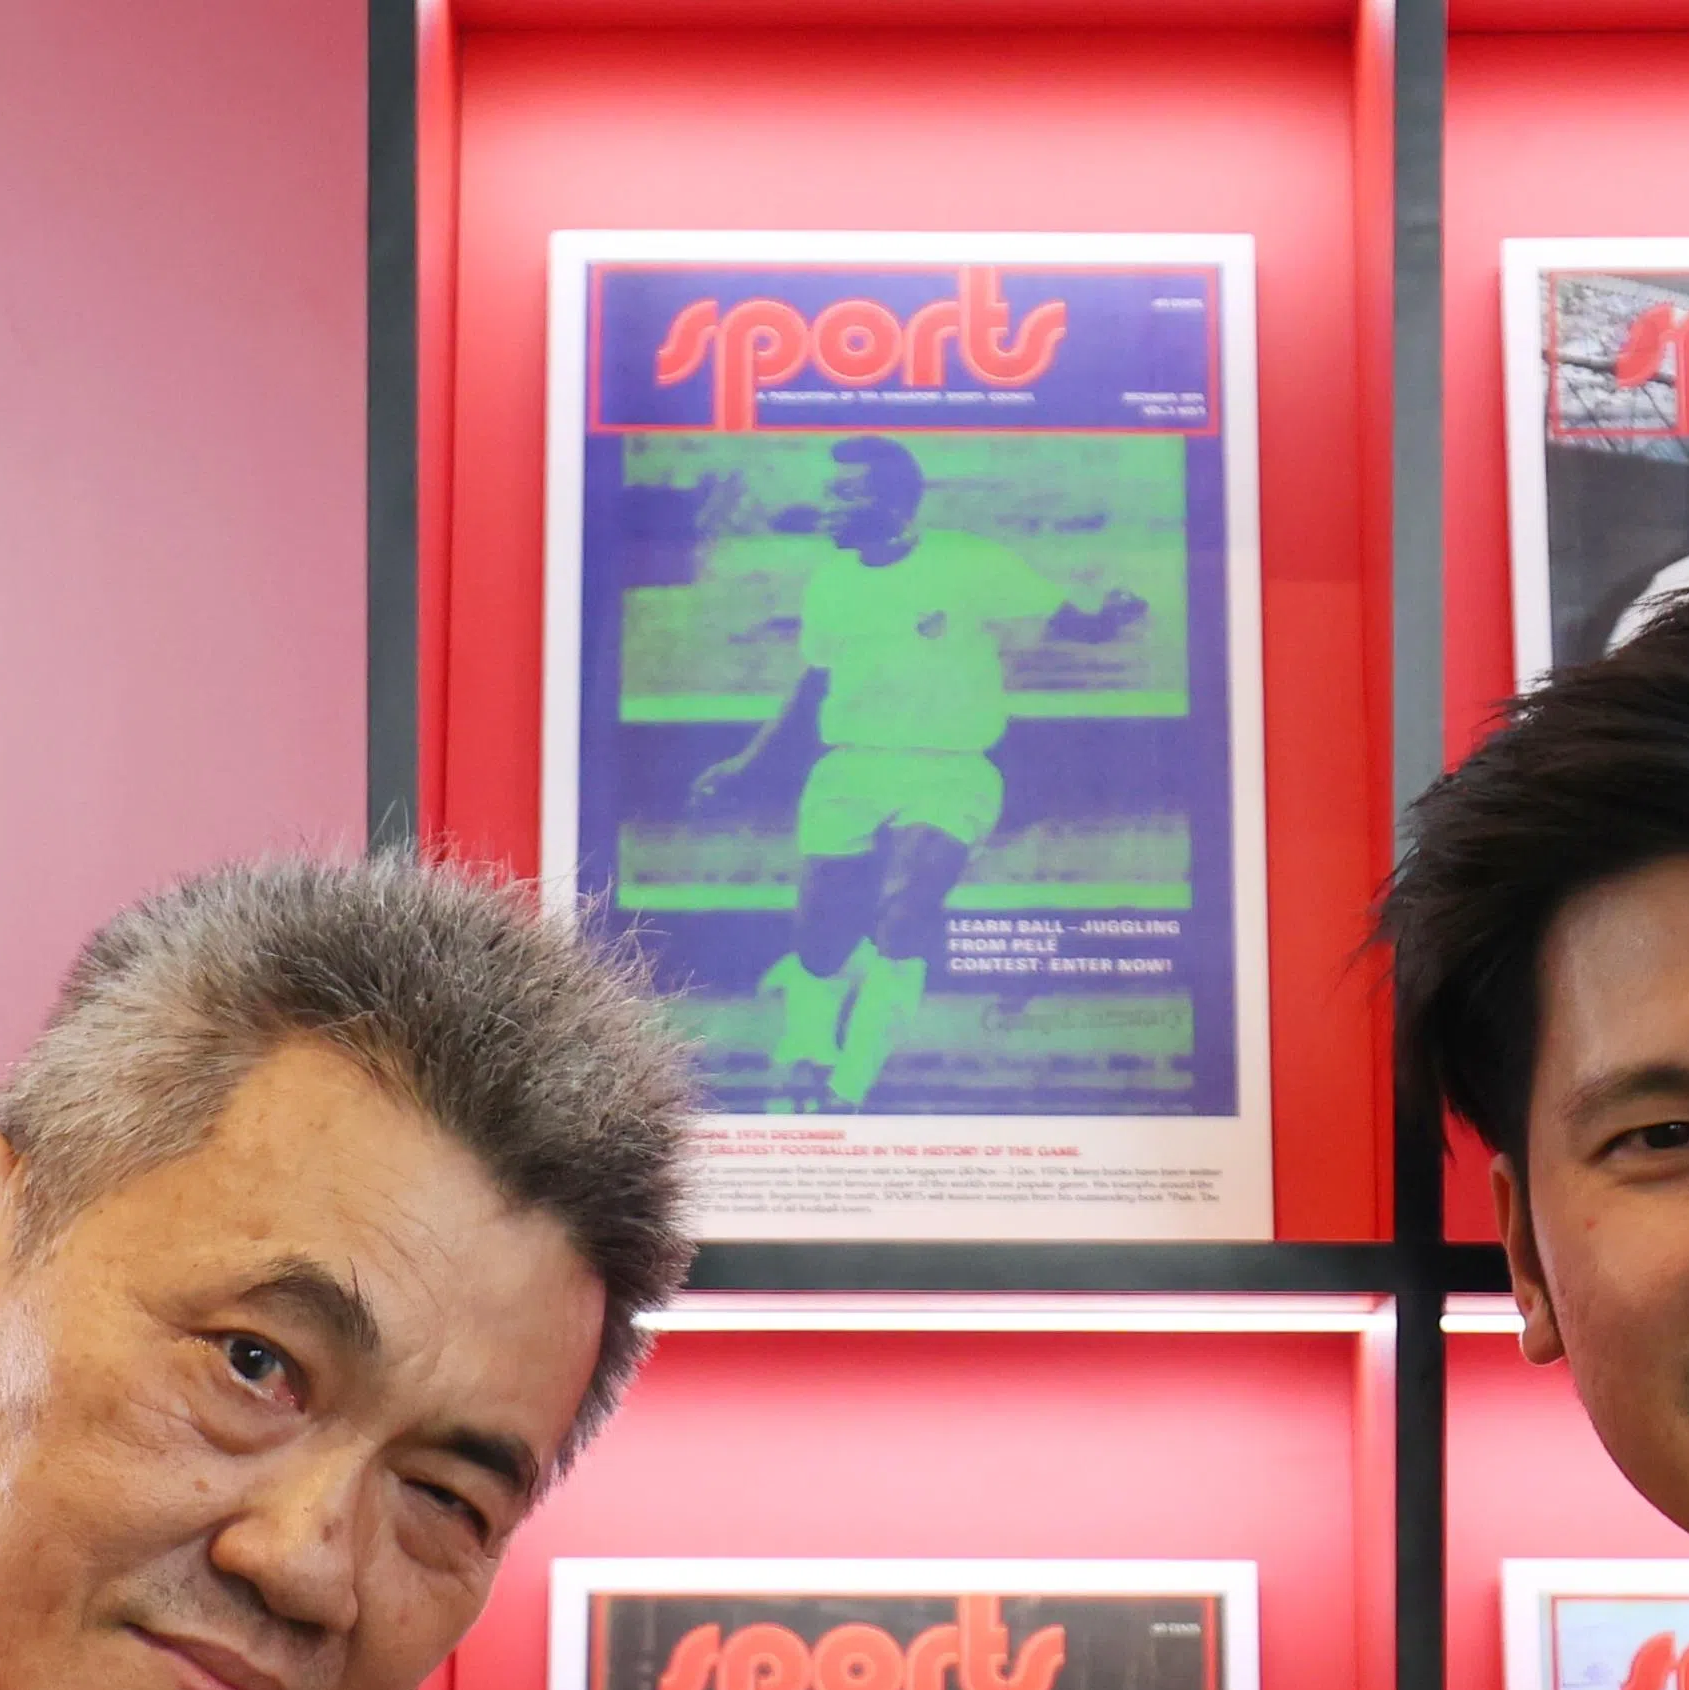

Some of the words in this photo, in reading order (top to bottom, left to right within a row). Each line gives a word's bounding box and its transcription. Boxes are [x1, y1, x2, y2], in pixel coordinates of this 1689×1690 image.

[655, 263, 1066, 430] sports
[948, 919, 1013, 935] LEARN
[948, 938, 1008, 953] FROM
[1050, 956, 1114, 973] ENTER
[1117, 956, 1173, 973] NOW!
